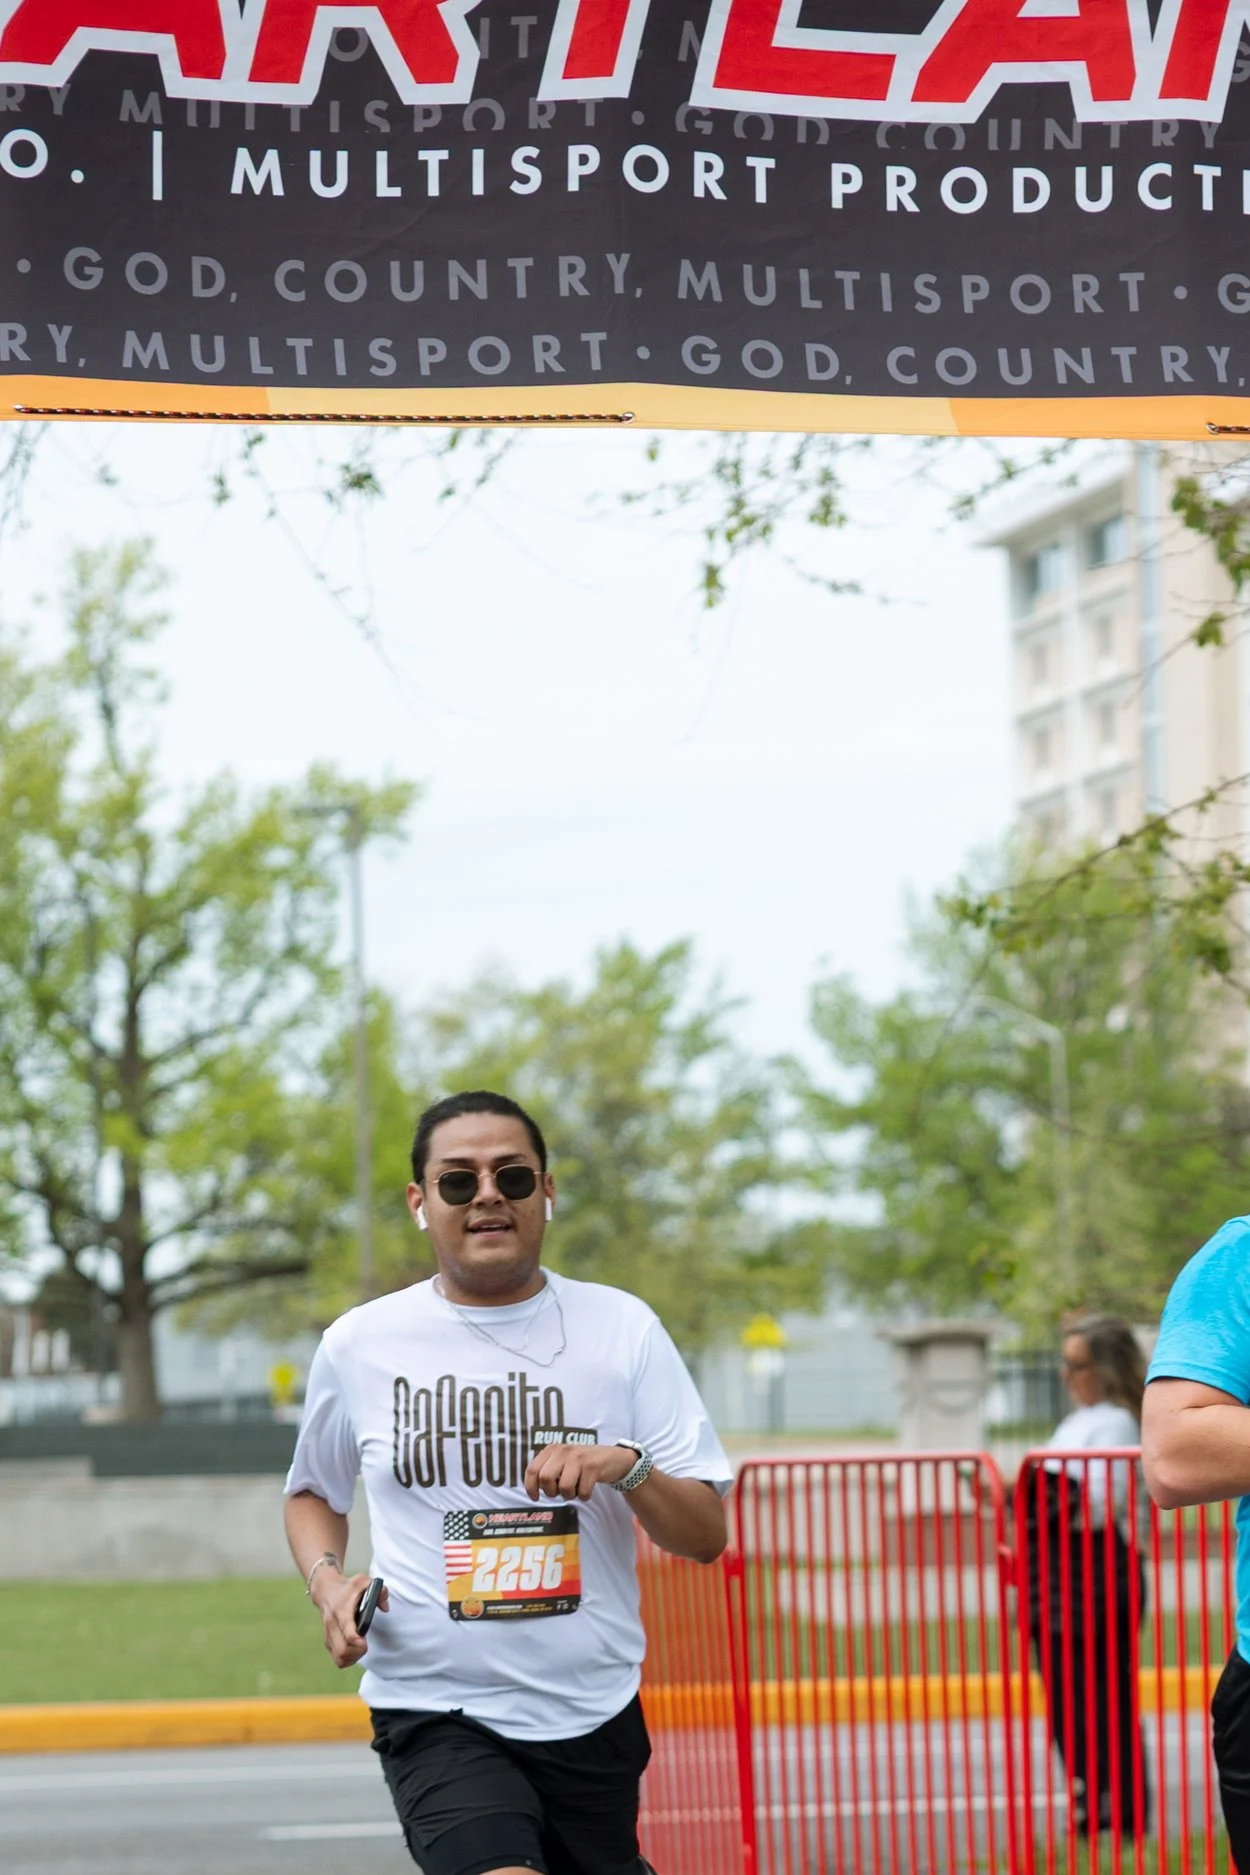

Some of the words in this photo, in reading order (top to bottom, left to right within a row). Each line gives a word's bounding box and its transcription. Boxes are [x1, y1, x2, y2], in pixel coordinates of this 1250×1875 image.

[231, 144, 776, 203] MULTISPORT
[63, 246, 238, 303] GOD,
[274, 252, 642, 303] COUNTRY,
[677, 259, 1145, 315] MULTISPORT
[122, 329, 608, 377] MULTISPORT
[681, 335, 853, 385] GOD,
[886, 344, 1245, 387] COUNTRY,
[533, 1430, 564, 1446] RUN
[566, 1432, 597, 1447] CLUB
[471, 1544, 566, 1593] 2256
